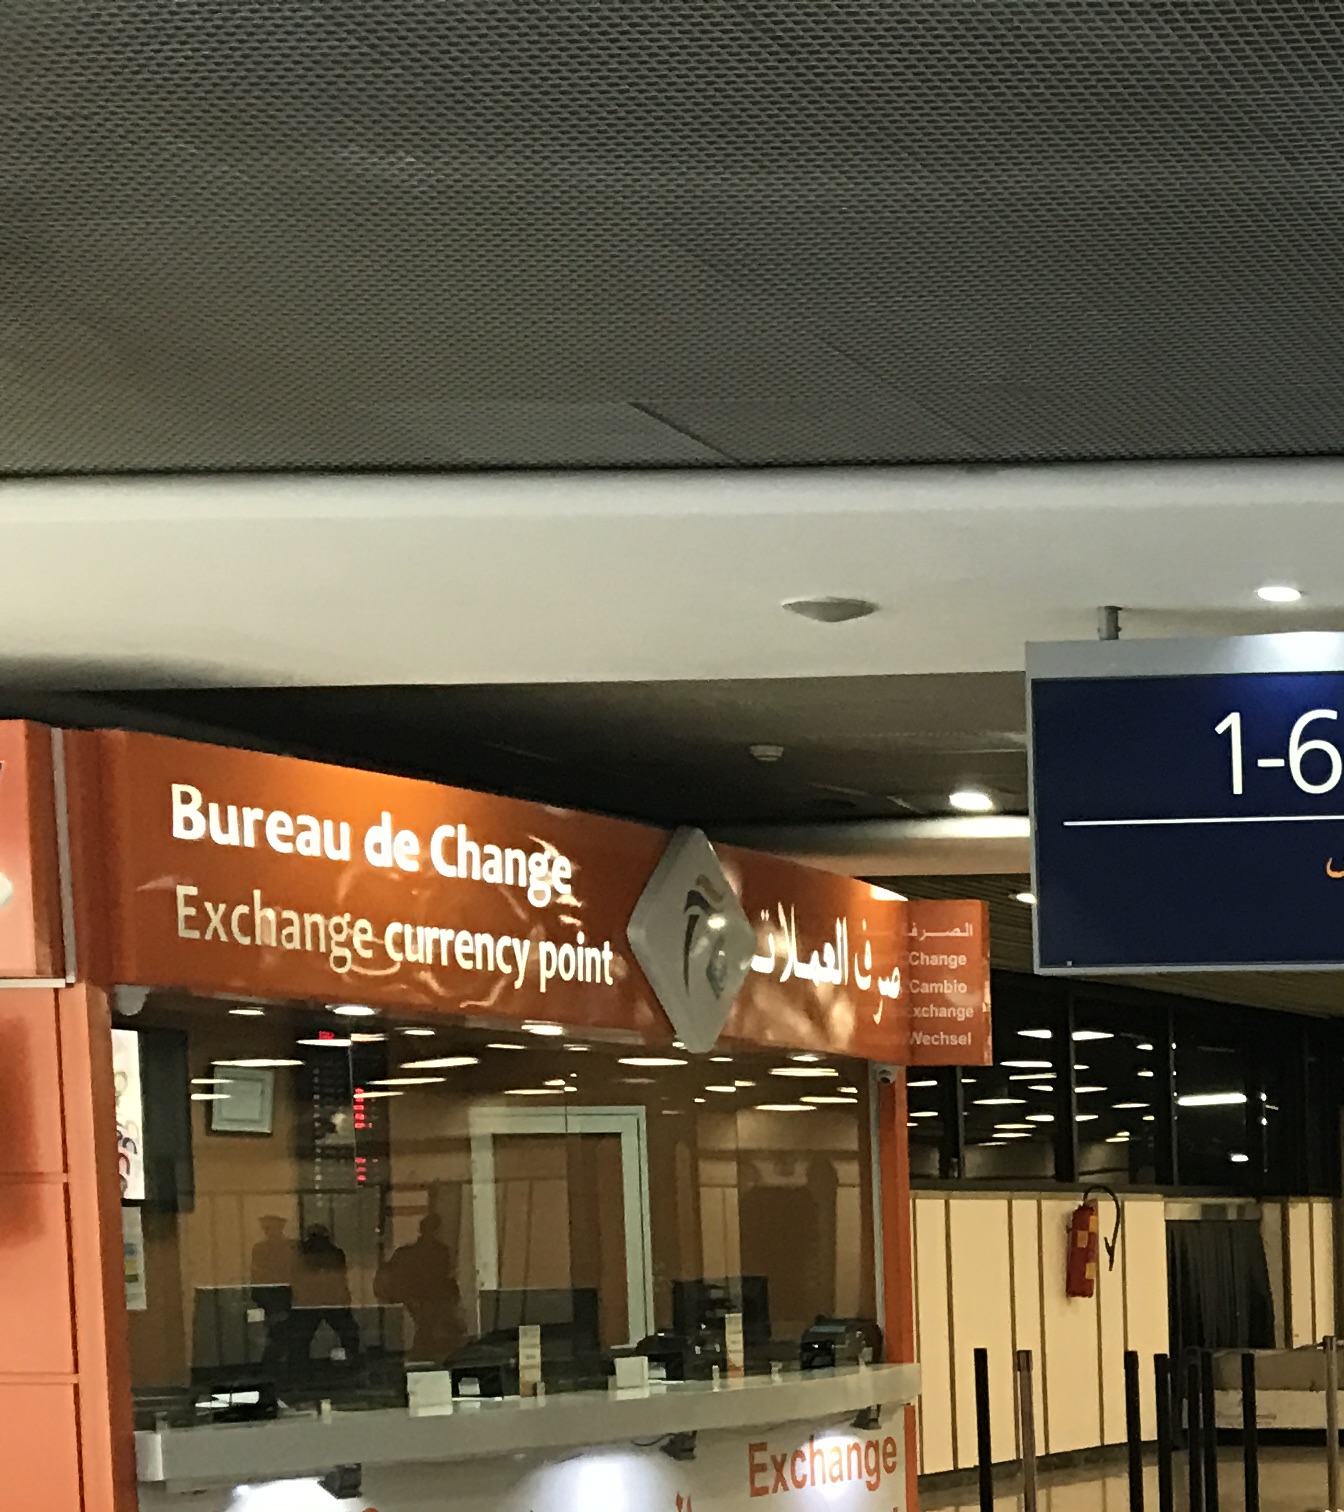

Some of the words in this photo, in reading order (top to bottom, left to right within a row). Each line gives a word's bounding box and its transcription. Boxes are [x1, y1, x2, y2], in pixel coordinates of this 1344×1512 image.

[1214, 709, 1343, 796] 1-6
[170, 783, 350, 862] Bureau
[364, 811, 420, 868] de
[430, 825, 574, 907] Change
[176, 884, 374, 974] Exchange
[385, 917, 532, 990] currency
[539, 926, 615, 990] point
[909, 952, 967, 968] Change
[909, 980, 967, 994] Cambio
[911, 1003, 974, 1020] xchange
[748, 1433, 898, 1498] Exchange
